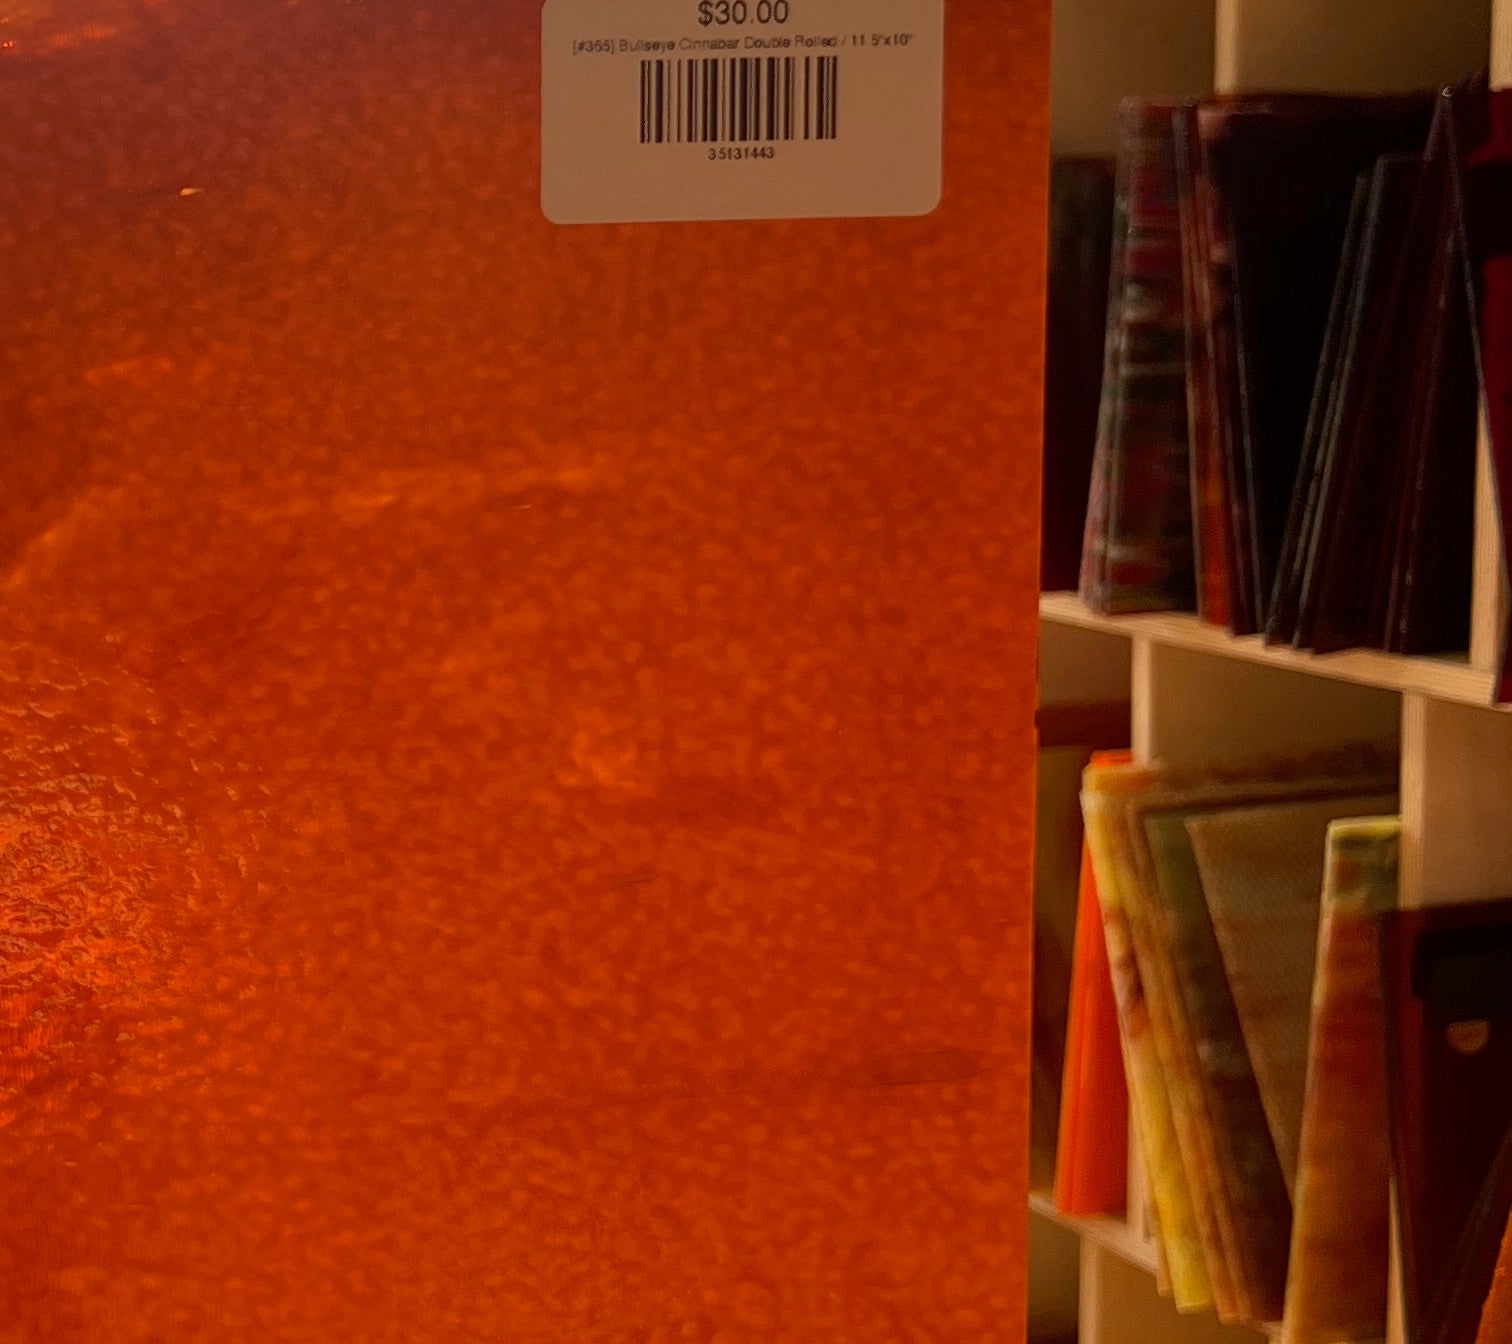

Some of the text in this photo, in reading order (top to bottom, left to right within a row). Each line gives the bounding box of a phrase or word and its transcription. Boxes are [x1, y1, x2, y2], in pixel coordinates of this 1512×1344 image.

[697, 0, 788, 26] $30.00
[619, 39, 675, 54] Bullseye
[679, 37, 739, 50] Cinnabar
[744, 36, 790, 48] Double
[794, 35, 837, 47] Rolled
[708, 147, 774, 160] 35131443
